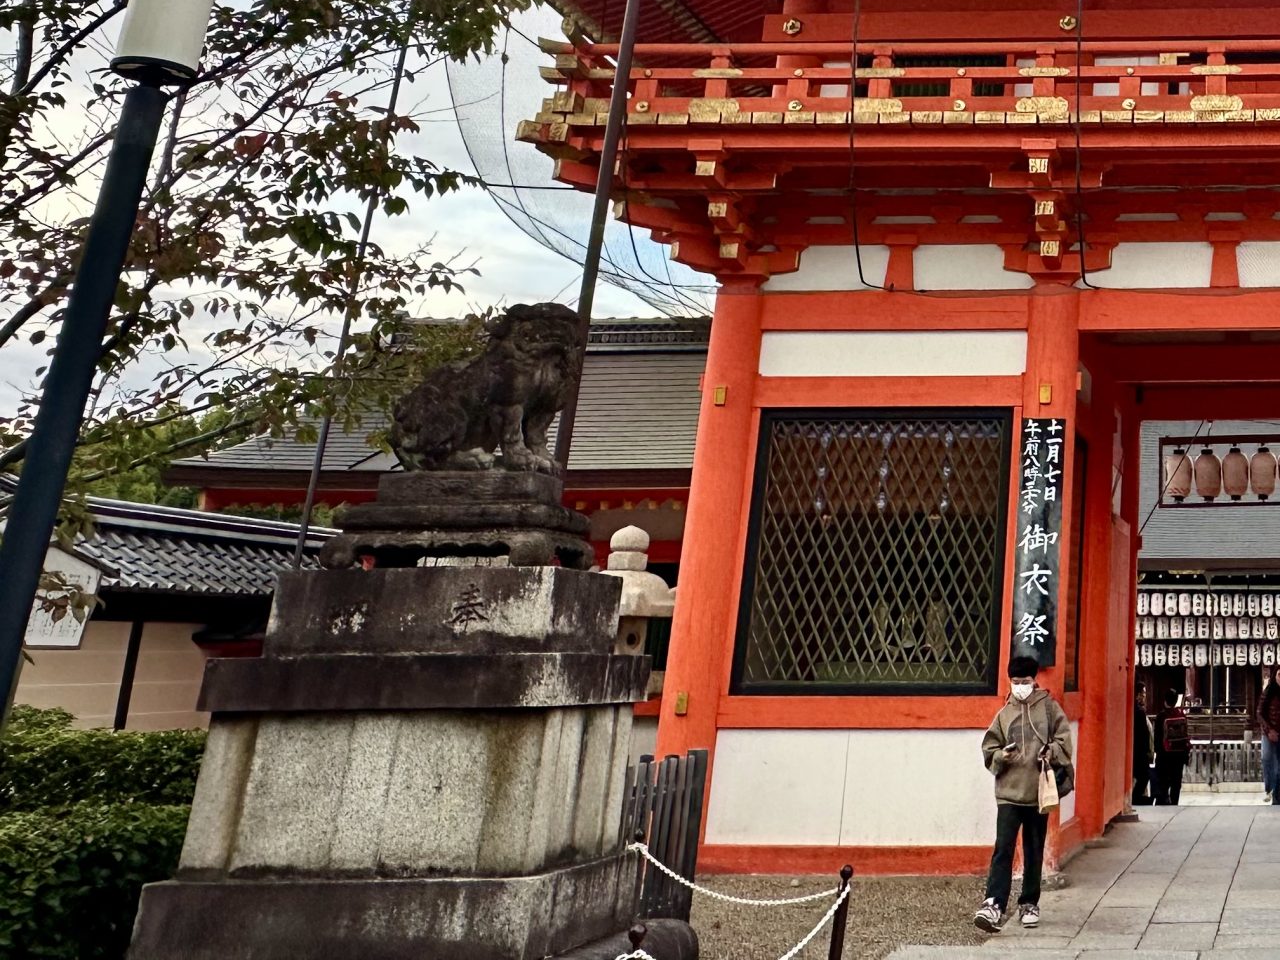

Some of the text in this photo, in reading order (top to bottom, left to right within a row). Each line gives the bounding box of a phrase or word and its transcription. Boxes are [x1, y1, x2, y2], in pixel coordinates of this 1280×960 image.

[1020, 418, 1042, 515] 午前八時三十分
[1043, 418, 1063, 502] 十一月七日
[446, 583, 490, 633] 奉
[1016, 524, 1059, 646] 御衣祭
